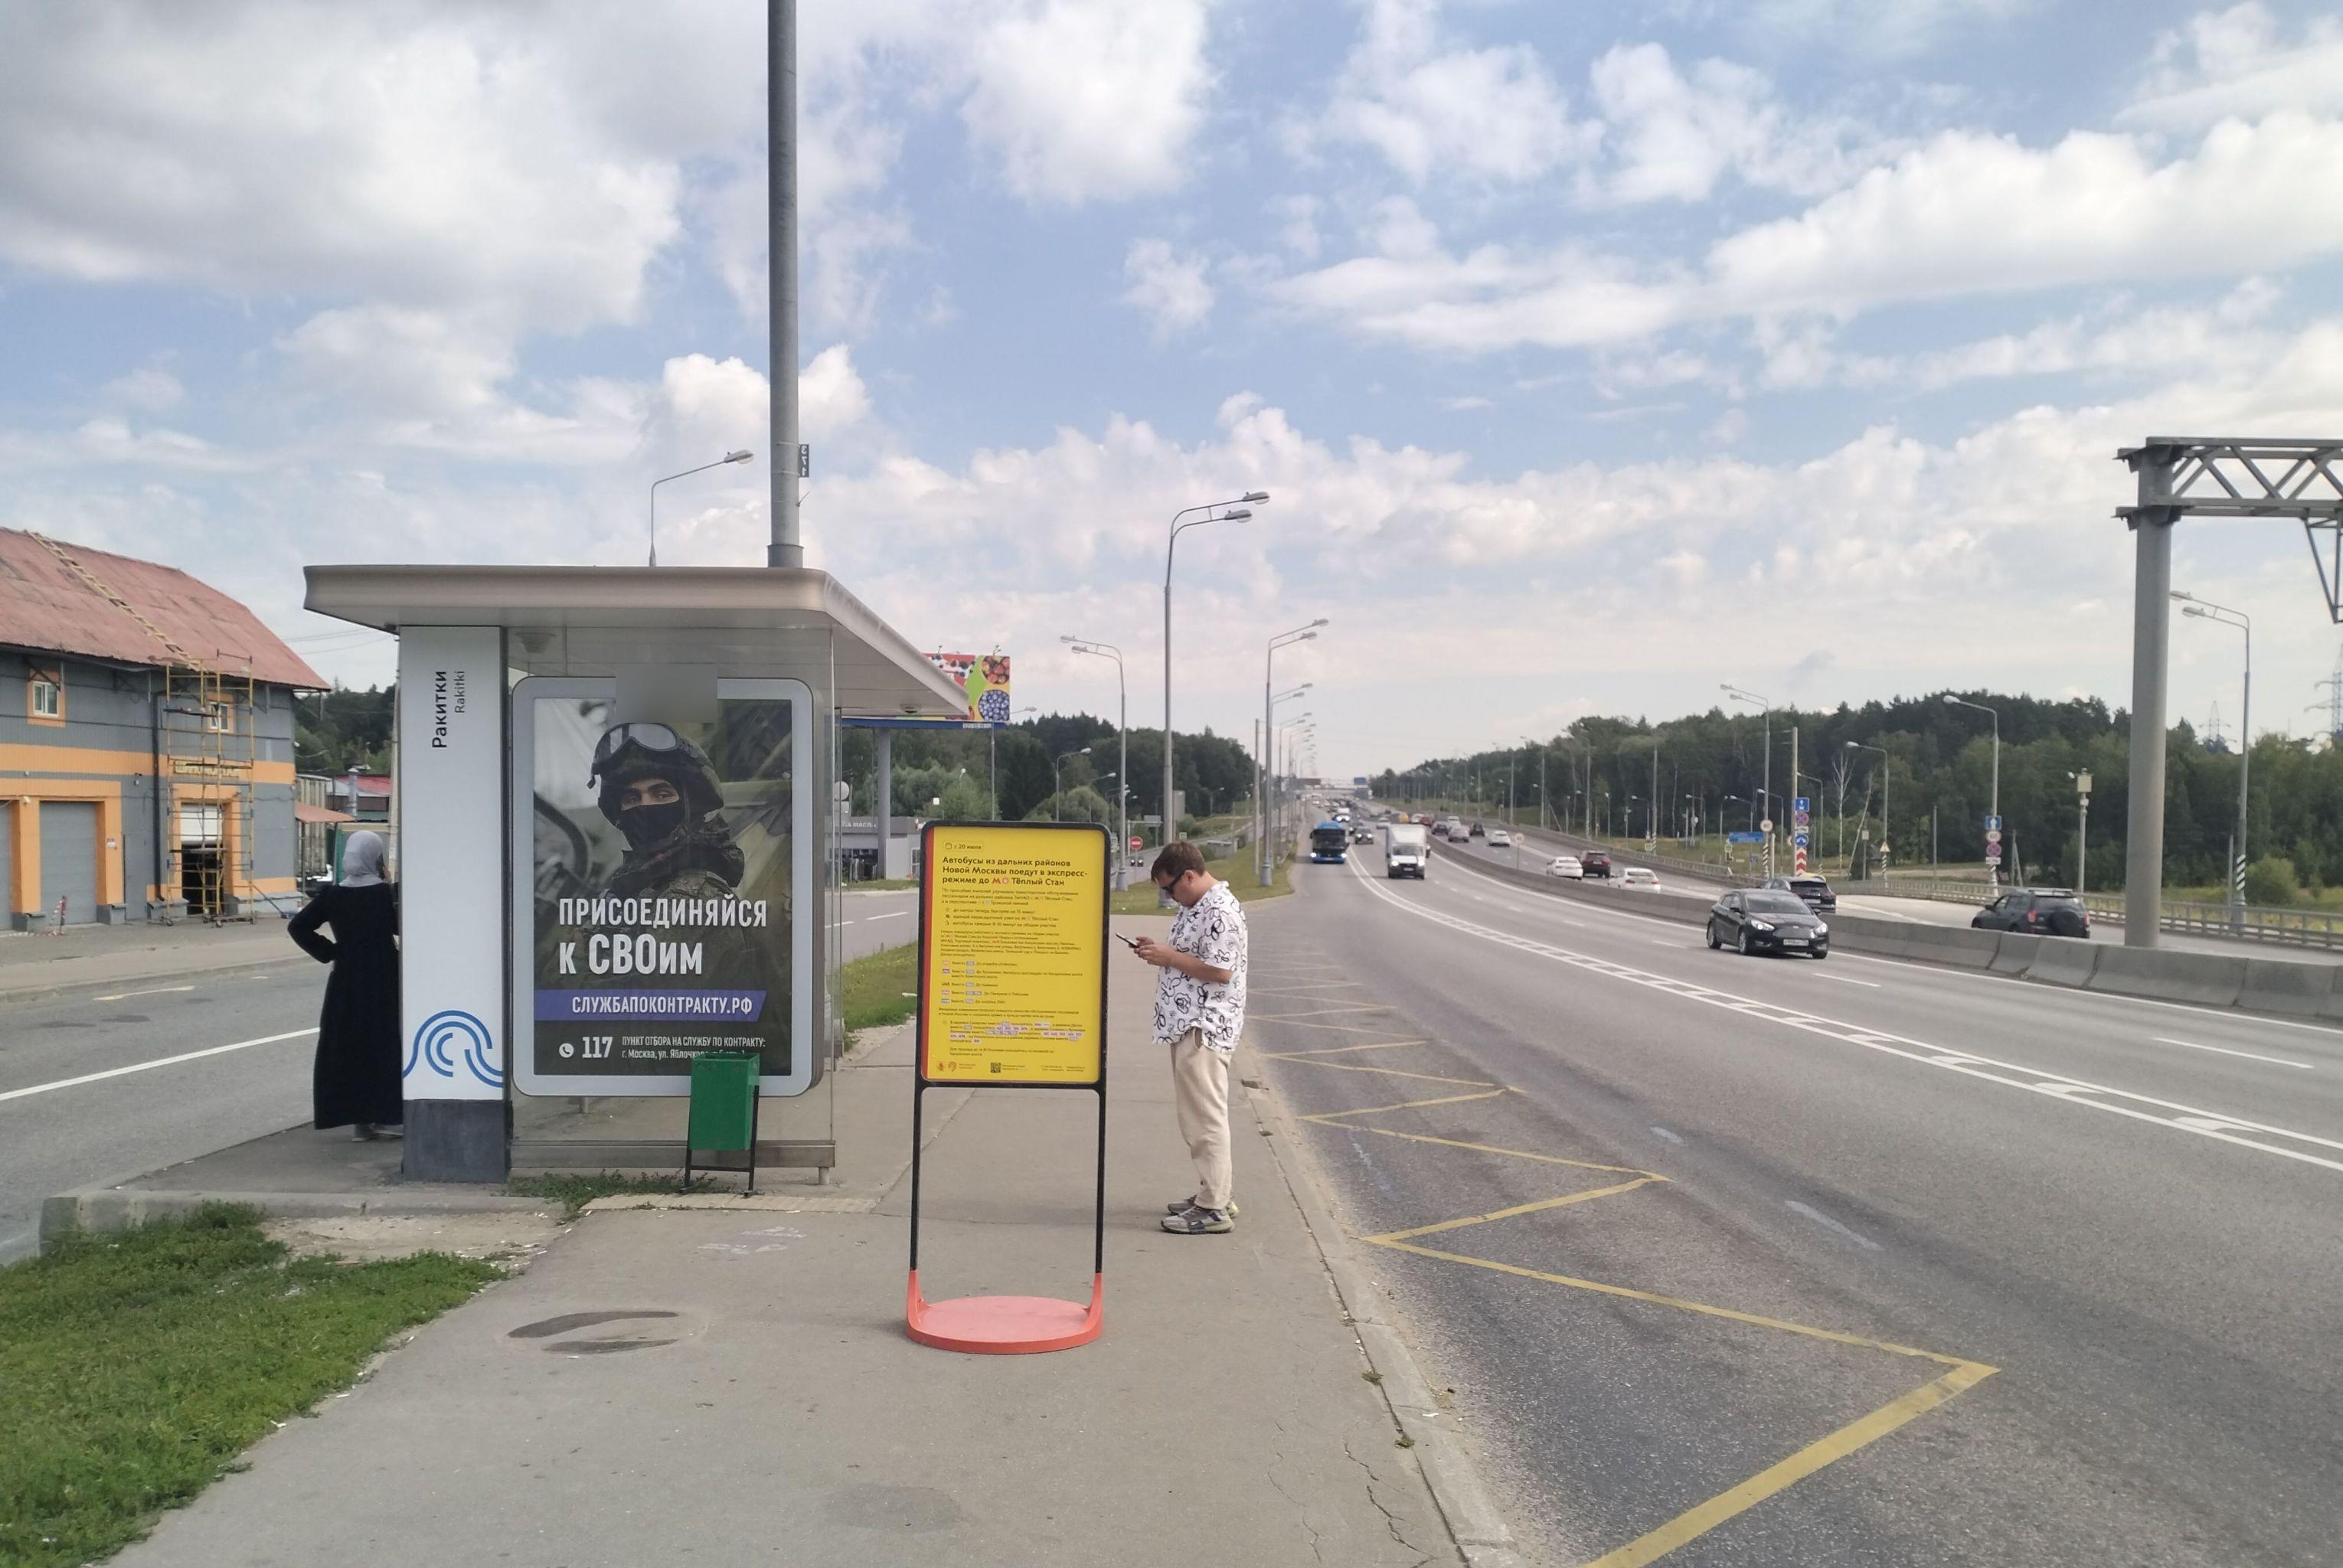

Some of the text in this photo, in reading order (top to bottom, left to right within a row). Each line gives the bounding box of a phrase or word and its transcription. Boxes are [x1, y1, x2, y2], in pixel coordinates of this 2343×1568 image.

[454, 671, 465, 714] Rakitki
[432, 671, 447, 748] Ракитки
[943, 857, 983, 865] Автобусы
[1034, 858, 1070, 867] районов
[943, 865, 970, 874] Новой
[1012, 877, 1043, 885] Тёплый
[559, 893, 766, 929] ПРИСОЕДИНЯЙСЯ
[572, 997, 753, 1015] СЛУЖБАПОКОНТРАКТУ.РФ
[582, 1036, 613, 1058] 117
[622, 1036, 766, 1047] ПУНКТ ОТБОРА НА СЛУЖБУ ПО КОНТРАКТУ:
[622, 1050, 627, 1058] г.
[628, 1049, 657, 1060] Москва,
[658, 1050, 668, 1060] ул.
